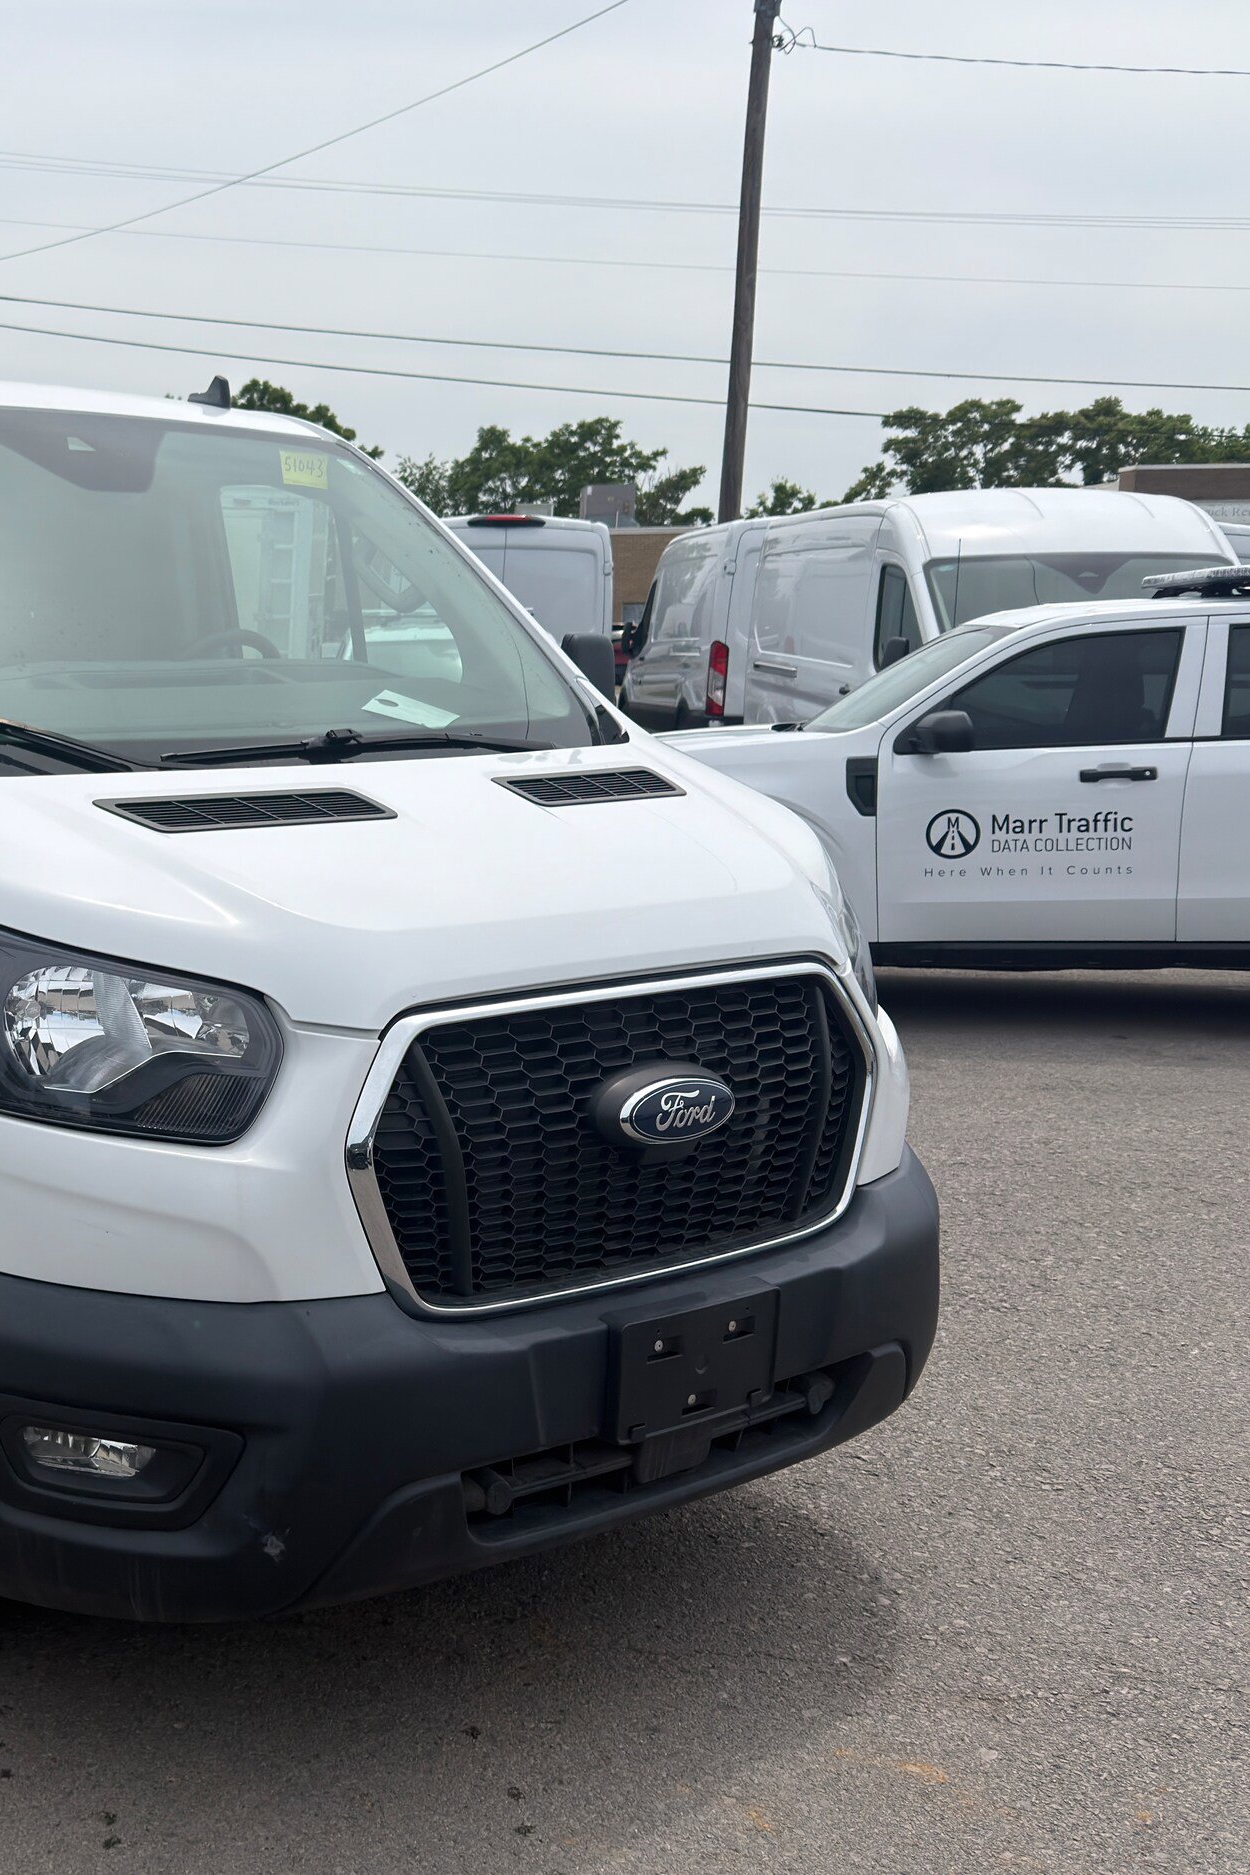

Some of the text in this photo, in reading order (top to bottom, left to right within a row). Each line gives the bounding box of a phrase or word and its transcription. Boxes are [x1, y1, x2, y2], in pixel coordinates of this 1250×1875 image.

[284, 456, 324, 478] 51043
[1207, 506, 1228, 517] uck
[992, 811, 1134, 834] Marr Traffic
[991, 837, 1132, 853] DATA COLLECTION
[924, 865, 1133, 877] Here When It Counts
[655, 1089, 716, 1131] Ford
